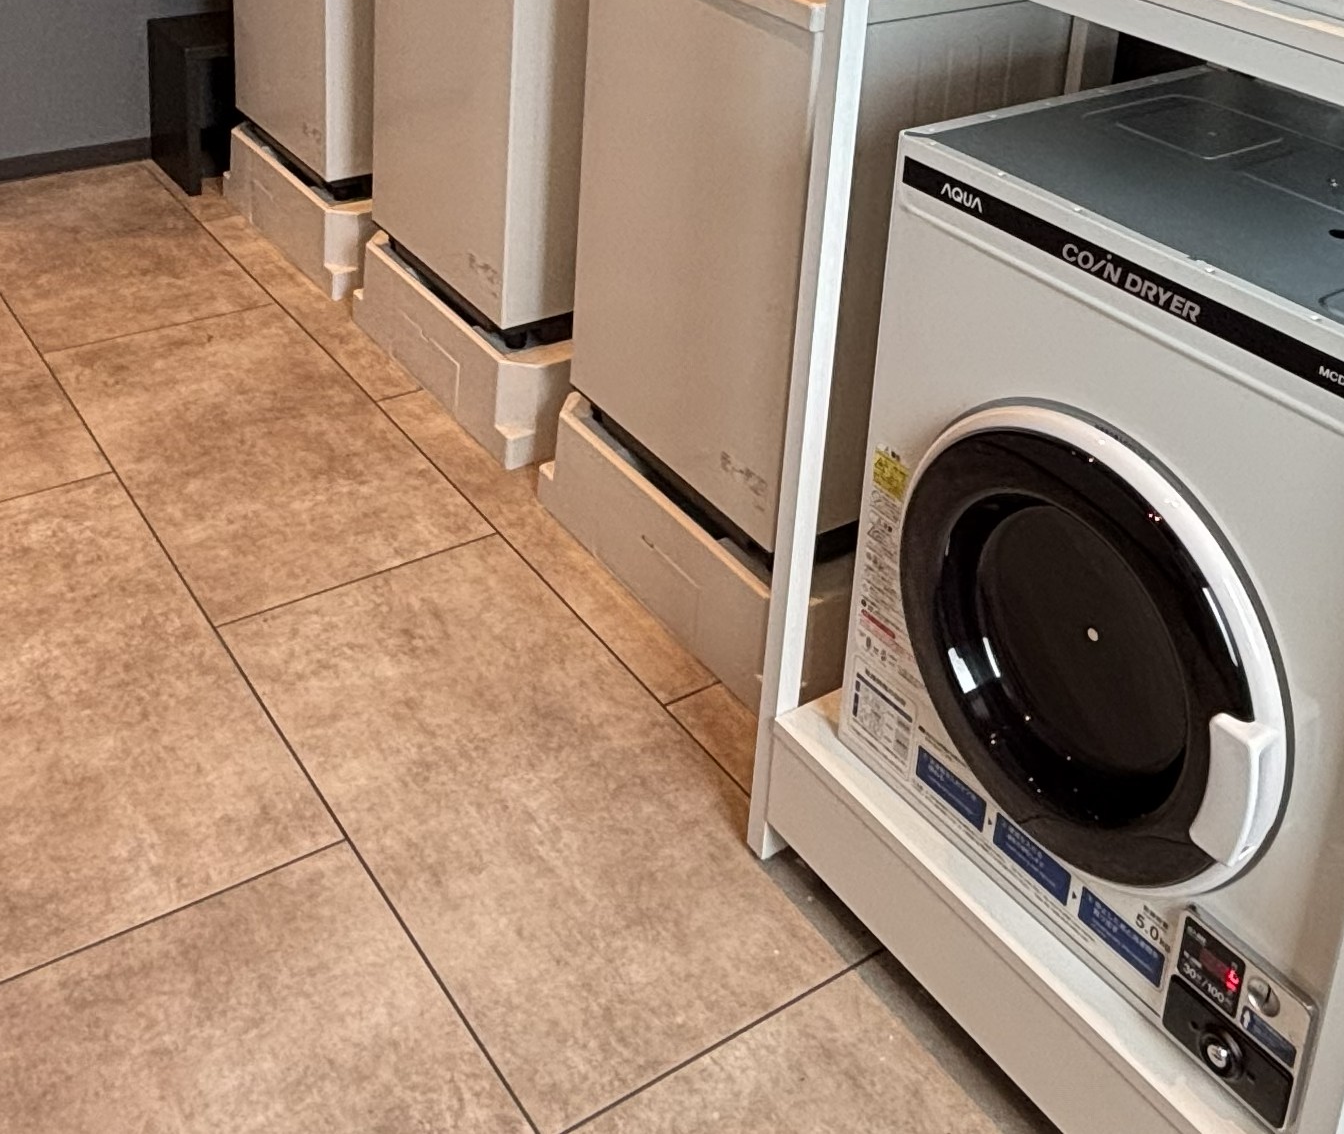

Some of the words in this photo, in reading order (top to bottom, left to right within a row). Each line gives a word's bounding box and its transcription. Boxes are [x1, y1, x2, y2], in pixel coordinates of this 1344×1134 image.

[940, 182, 983, 214] AQUA
[1062, 243, 1123, 286] COIN
[1124, 272, 1202, 324] DRYER
